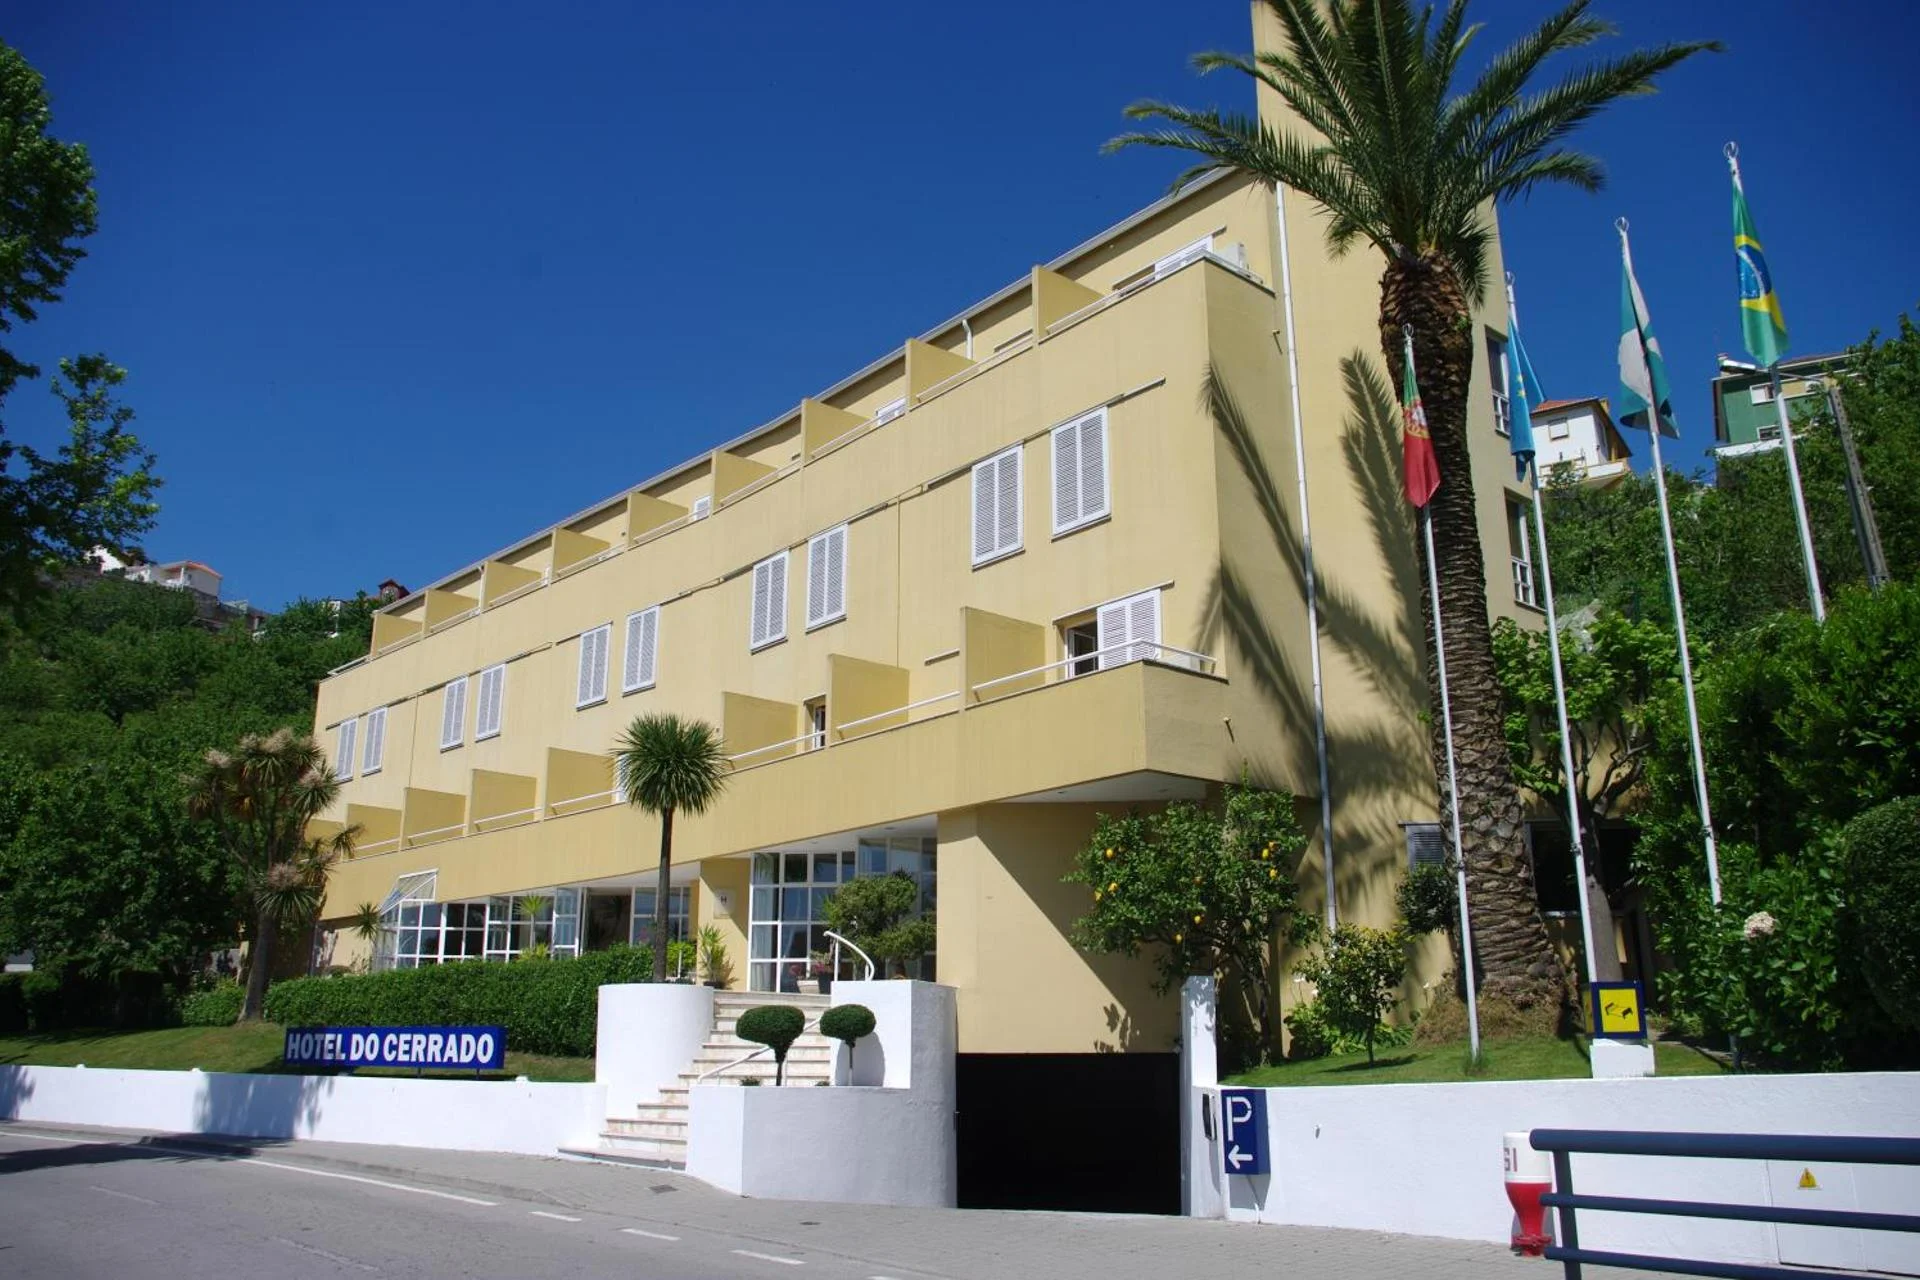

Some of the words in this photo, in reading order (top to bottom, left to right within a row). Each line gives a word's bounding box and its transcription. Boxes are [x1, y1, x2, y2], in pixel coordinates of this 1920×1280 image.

[287, 1033, 346, 1060] HOTEL
[350, 1033, 380, 1061] DO
[383, 1033, 494, 1064] CERRADO
[1226, 1096, 1253, 1142] P
